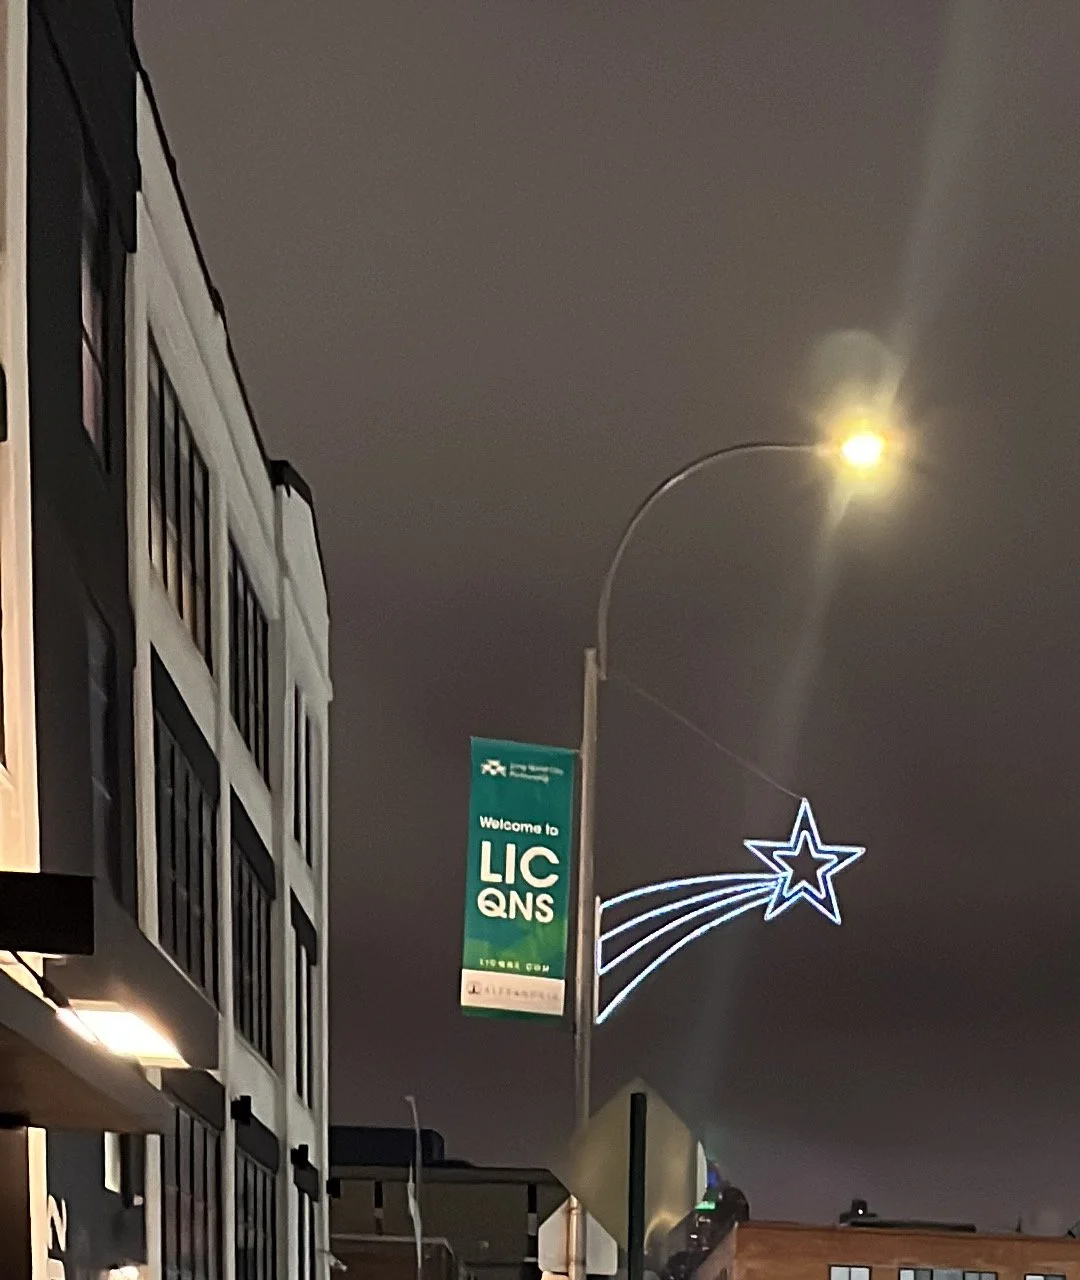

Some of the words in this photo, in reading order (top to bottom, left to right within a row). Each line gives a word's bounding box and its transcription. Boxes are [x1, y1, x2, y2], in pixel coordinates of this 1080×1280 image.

[480, 815, 542, 835] Welcome
[545, 823, 559, 836] to
[481, 840, 560, 888] LIC
[477, 887, 554, 923] QNS
